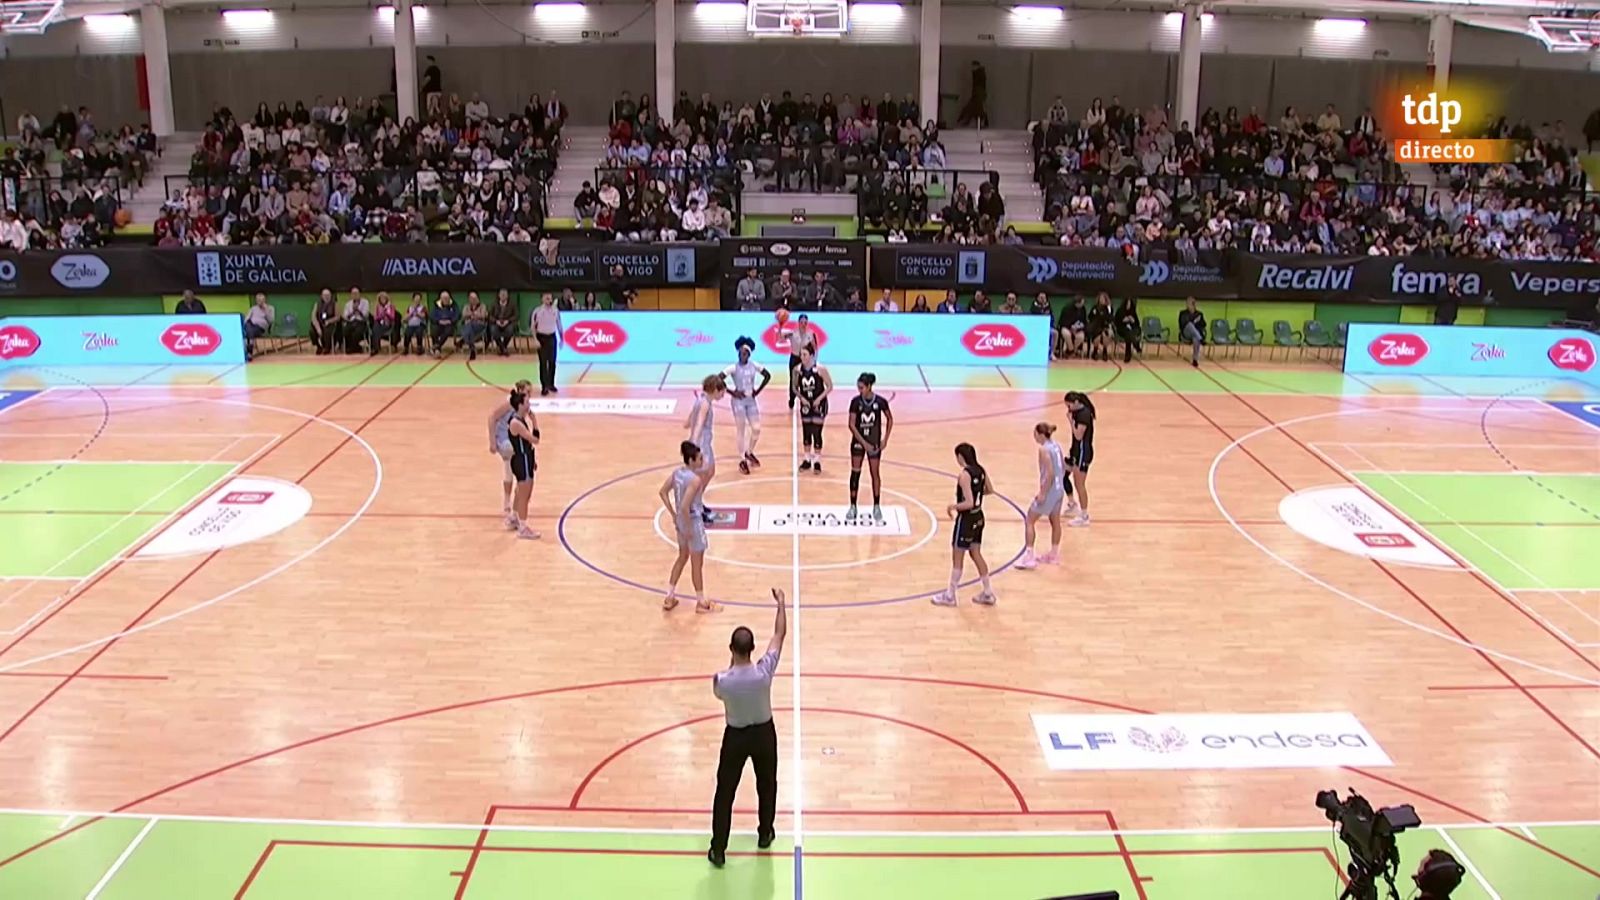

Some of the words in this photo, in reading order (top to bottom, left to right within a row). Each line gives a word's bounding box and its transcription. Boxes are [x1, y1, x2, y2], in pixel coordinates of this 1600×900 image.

[225, 254, 275, 268] XUNTA
[602, 255, 660, 265] CONCELLO
[900, 256, 952, 267] CONCELLO
[1061, 261, 1115, 272] Deputación
[225, 269, 245, 283] DE
[249, 269, 308, 283] GALICIA
[627, 266, 653, 276] VIGO
[906, 266, 920, 276] DE
[924, 267, 946, 277] VIGO
[1061, 270, 1115, 279] Pontevedra
[1257, 264, 1354, 291] Recalvi
[574, 327, 615, 347] Zorka
[974, 330, 1013, 350] Zorka
[1380, 339, 1416, 360] Zorka
[1048, 731, 1117, 751] LF
[1201, 730, 1369, 750] endesa
